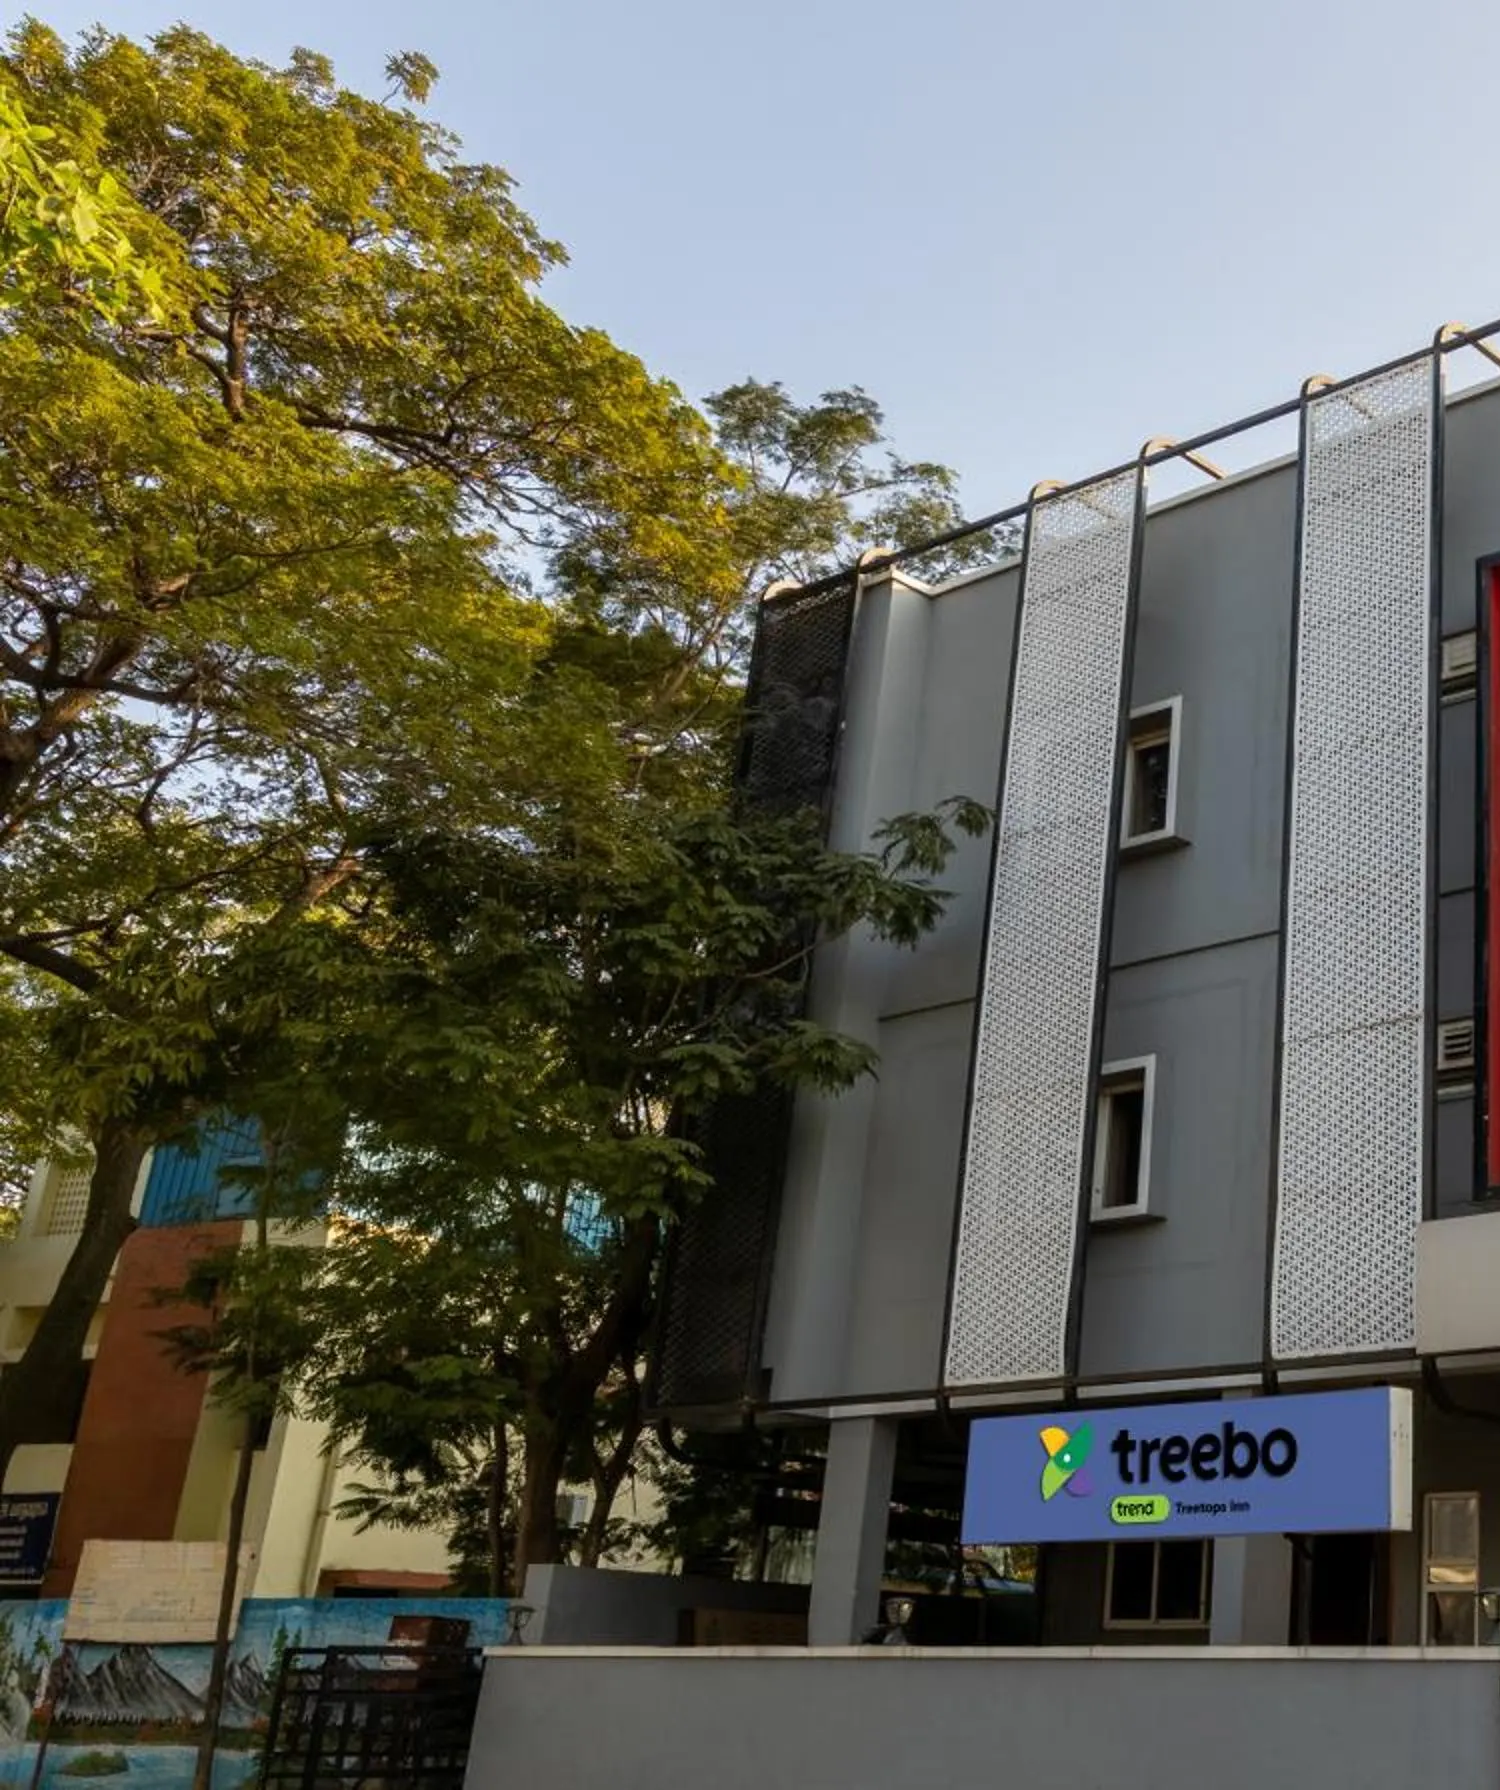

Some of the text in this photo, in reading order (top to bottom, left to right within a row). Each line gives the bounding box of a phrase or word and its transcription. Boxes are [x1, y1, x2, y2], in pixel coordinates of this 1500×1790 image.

[1111, 1421, 1298, 1483] treebo
[1116, 1501, 1155, 1517] trend
[1176, 1501, 1227, 1516] Treetops
